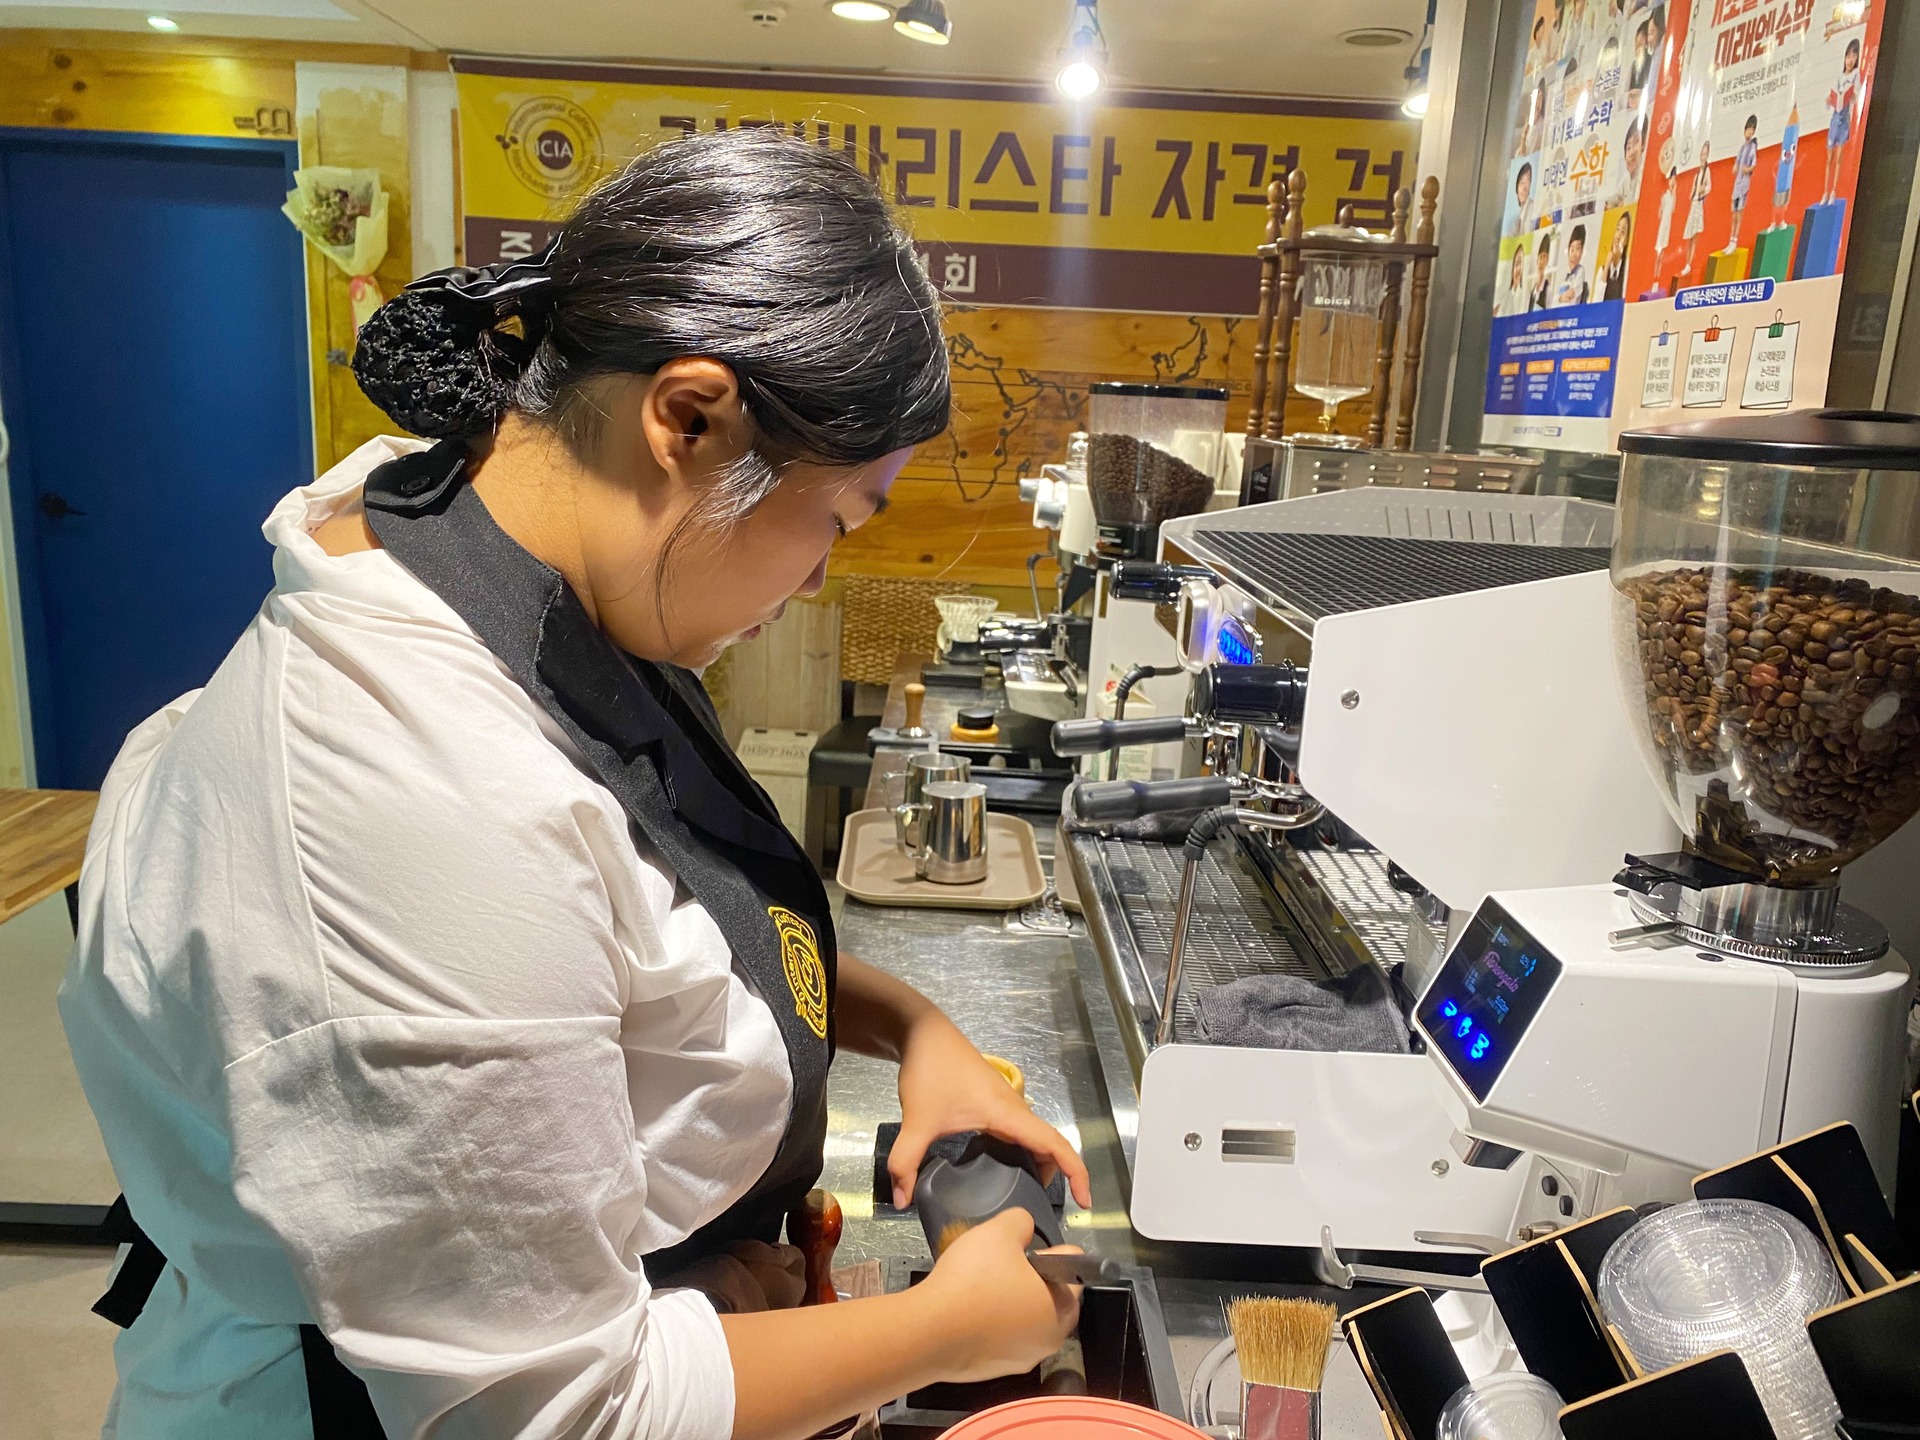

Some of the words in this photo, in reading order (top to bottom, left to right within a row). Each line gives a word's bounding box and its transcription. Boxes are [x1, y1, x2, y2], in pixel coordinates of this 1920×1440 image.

[1588, 99, 1613, 132] 수학
[535, 139, 573, 158] ICIA
[660, 115, 1121, 216] 바리스타
[1335, 147, 1420, 229] 검
[1569, 141, 1611, 192] 수학
[1728, 282, 1766, 302] 학습시스템
